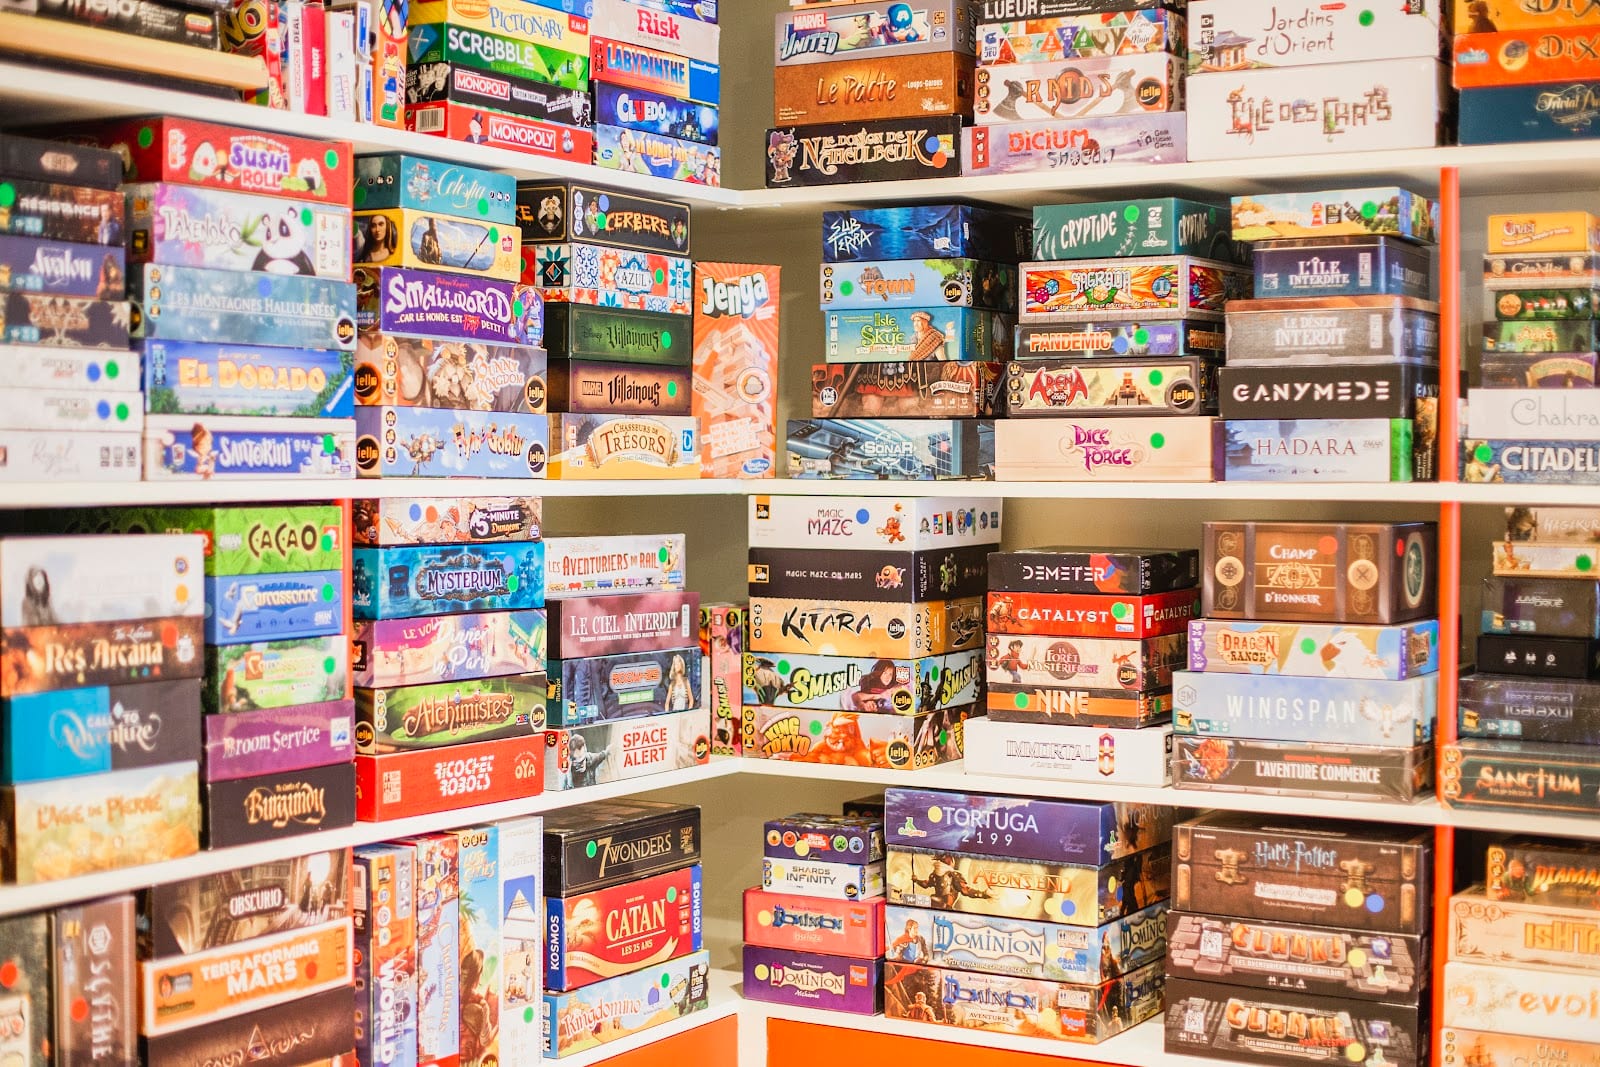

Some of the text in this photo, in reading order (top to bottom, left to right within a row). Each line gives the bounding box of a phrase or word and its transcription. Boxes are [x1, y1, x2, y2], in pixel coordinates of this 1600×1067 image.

[793, 12, 827, 31] MARVEL
[984, 0, 1038, 19] LUEUR
[1264, 7, 1335, 32] Jardins
[489, 7, 564, 41] PICTIONARY
[637, 9, 680, 40] Risk
[448, 28, 534, 68] SCRABBLE
[781, 33, 839, 60] UNITED
[1257, 32, 1335, 56] d'Orient
[606, 42, 686, 85] LABYRINTHE
[456, 71, 509, 98] MONOPOLY
[817, 72, 897, 105] Le Pacte
[616, 93, 667, 122] CLUEDO
[490, 119, 554, 149] MONOPOLY
[604, 211, 672, 237] CERBERE
[831, 216, 861, 238] SUB
[1060, 211, 1118, 250] CRYPTIDE
[828, 231, 874, 260] TERRA
[620, 271, 650, 289] AZUL
[863, 275, 916, 297] TOWN
[1288, 273, 1351, 286] INTERDITE
[702, 272, 769, 317] Jenga
[874, 312, 896, 328] Isle
[861, 324, 906, 348] Skye
[1029, 331, 1113, 353] PANDEMIC
[1274, 328, 1348, 347] INTERDIT
[178, 358, 327, 393] EL DORADO
[607, 373, 661, 407] Villainous
[1233, 380, 1391, 403] GANYMEDE
[1511, 395, 1600, 426] Chakra
[600, 429, 666, 455] TRÉSORS
[863, 439, 914, 457] SONAR
[1072, 424, 1110, 447] DICE
[1257, 438, 1357, 458] HADARA
[1084, 445, 1133, 472] FORGE
[817, 508, 844, 519] MAGIC
[807, 519, 855, 537] MAZE
[561, 553, 629, 577] AVENTURIERS
[639, 553, 660, 571] RAIL
[1269, 544, 1318, 560] CHAMP
[427, 569, 502, 593] MYSTERIUM
[785, 569, 808, 580] MAGIC
[809, 570, 830, 580] MAZE
[844, 571, 863, 580] MARS
[1021, 565, 1106, 582] DEMETER
[570, 611, 680, 637] LE CIEL INTERDIT
[1017, 607, 1110, 623] CATALYST
[1154, 604, 1192, 622] CATALYST
[45, 637, 164, 675] Res Arcana
[1230, 650, 1268, 664] RANCH
[789, 671, 847, 705] SMASH
[404, 692, 515, 736] Alchimistes
[1034, 688, 1090, 720] NINE
[1226, 694, 1357, 724] WINGSPAN
[623, 728, 668, 749] SPACE
[765, 716, 802, 741] KING
[223, 724, 322, 760] Broom Service
[763, 733, 811, 758] TOKYO
[514, 760, 537, 781] OYA
[623, 746, 667, 770] ALERT
[1256, 760, 1381, 785] L'AVENTURE COMMENCE
[942, 805, 1040, 834] TORTUGA
[597, 833, 673, 878] 7 WONDERS
[786, 869, 838, 886] INFINITY
[792, 865, 831, 876] SHARDS
[229, 887, 283, 917] OBSCURIO
[692, 881, 702, 935] KOSMOS
[605, 896, 667, 943] CATAN
[550, 914, 561, 971] KOSMOS
[935, 914, 1044, 958] DOMINION
[201, 940, 321, 983] TERRAFORMING
[622, 945, 633, 957] LES
[227, 961, 298, 996] MARS
[771, 963, 846, 991] DOMINION
[379, 958, 396, 1064] WORLD
[560, 996, 642, 1040] Kingdomino
